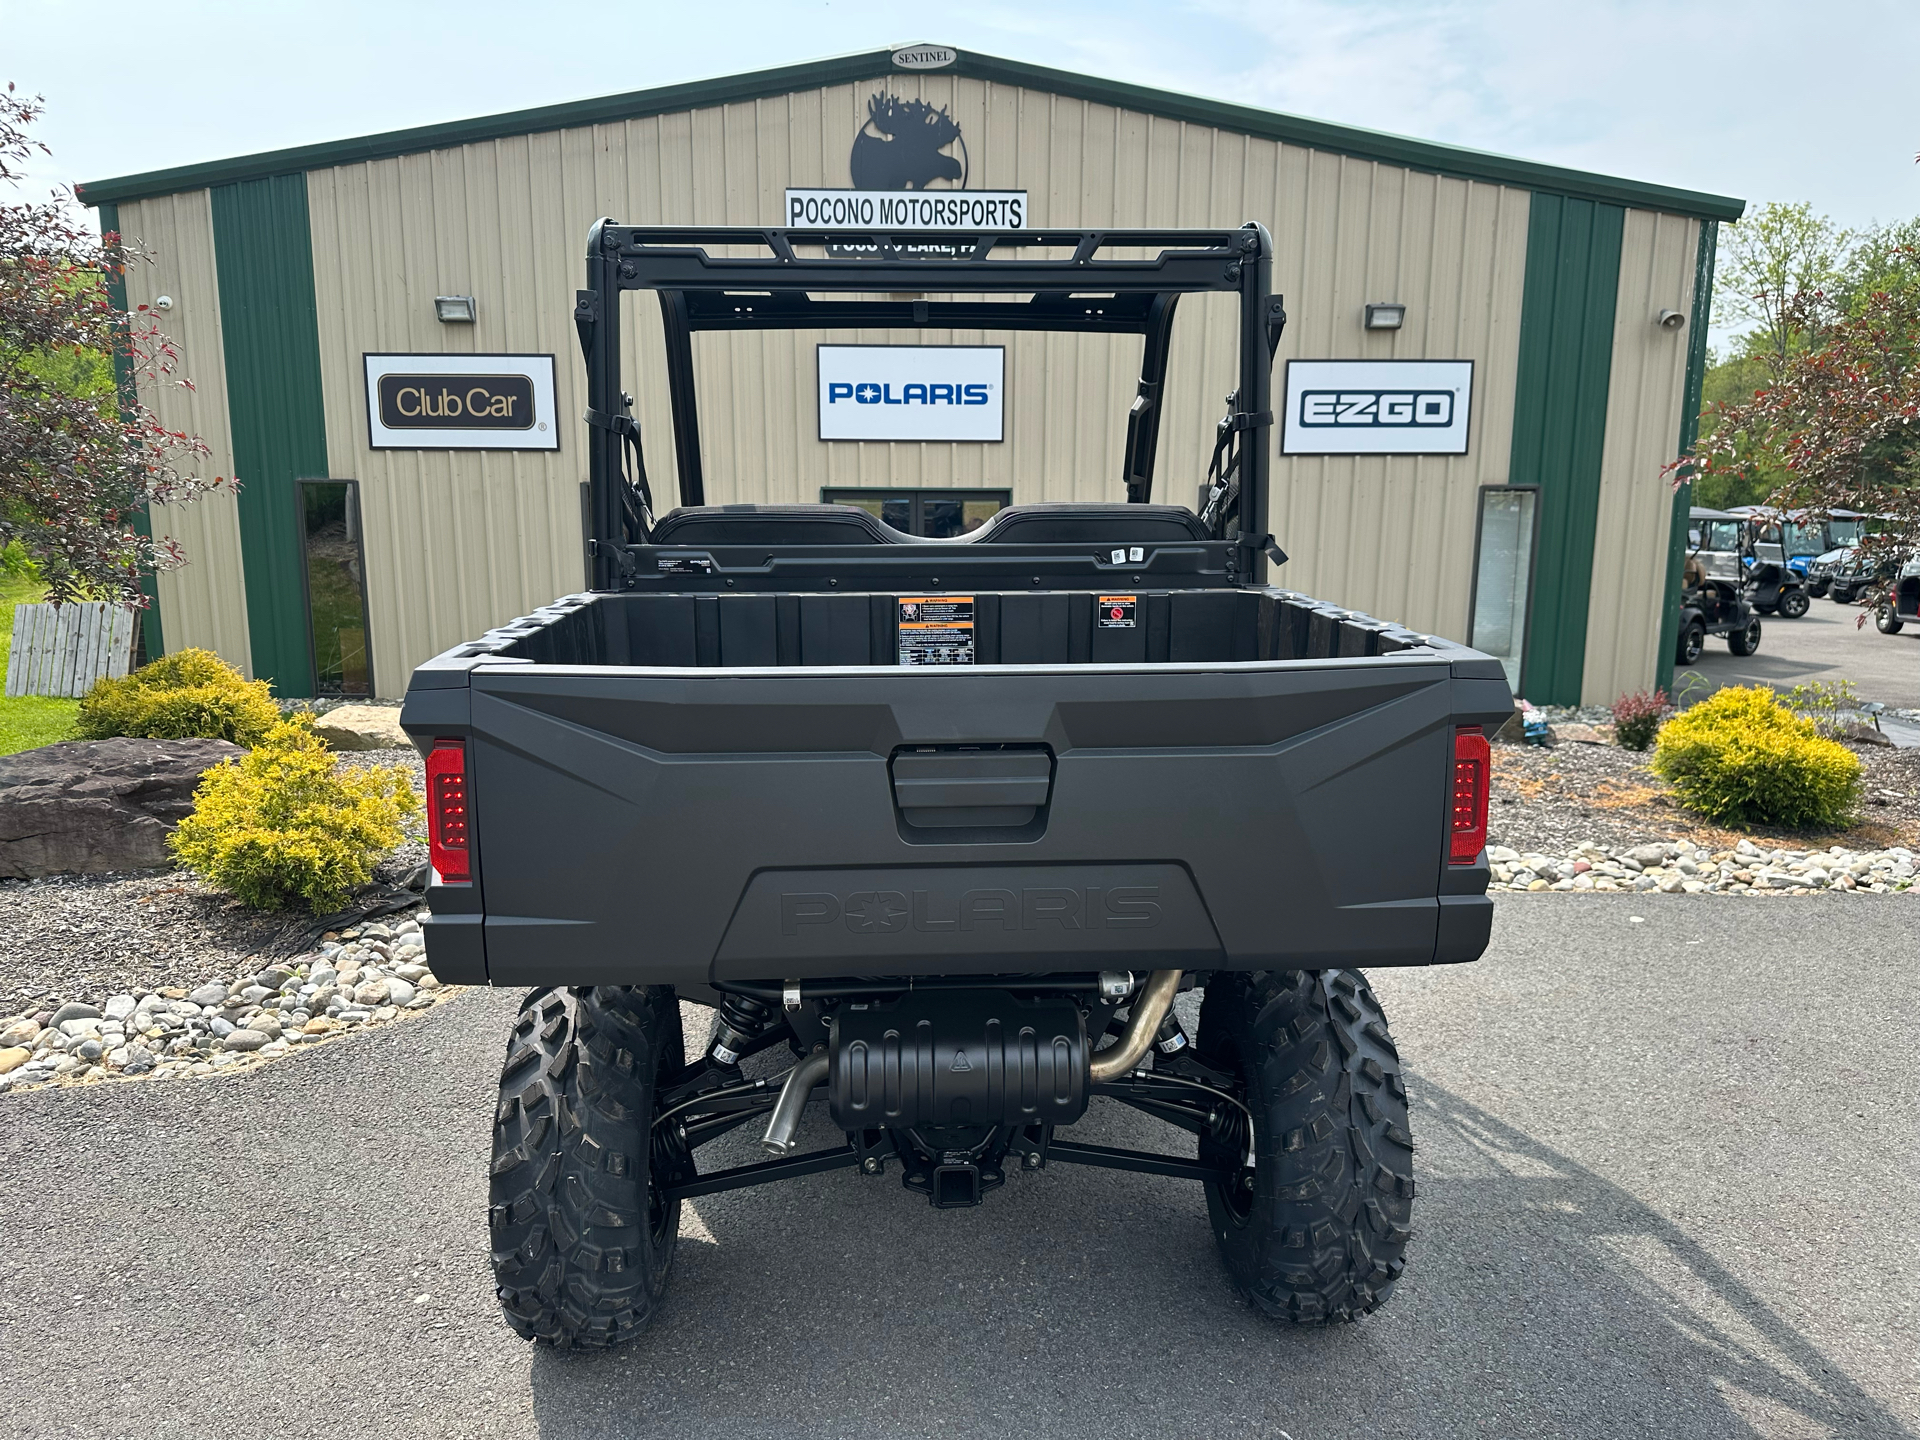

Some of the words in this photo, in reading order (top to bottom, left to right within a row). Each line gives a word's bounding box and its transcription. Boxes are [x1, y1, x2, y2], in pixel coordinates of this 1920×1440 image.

[898, 51, 950, 64] SENTINEL
[790, 197, 874, 227] POCONO
[880, 198, 1022, 229] MOTORSPORTS
[396, 387, 463, 417] Club
[466, 387, 517, 417] Car
[829, 383, 989, 405] POLARIS
[1303, 394, 1451, 424] EZGO
[780, 886, 1163, 936] POLARIS
